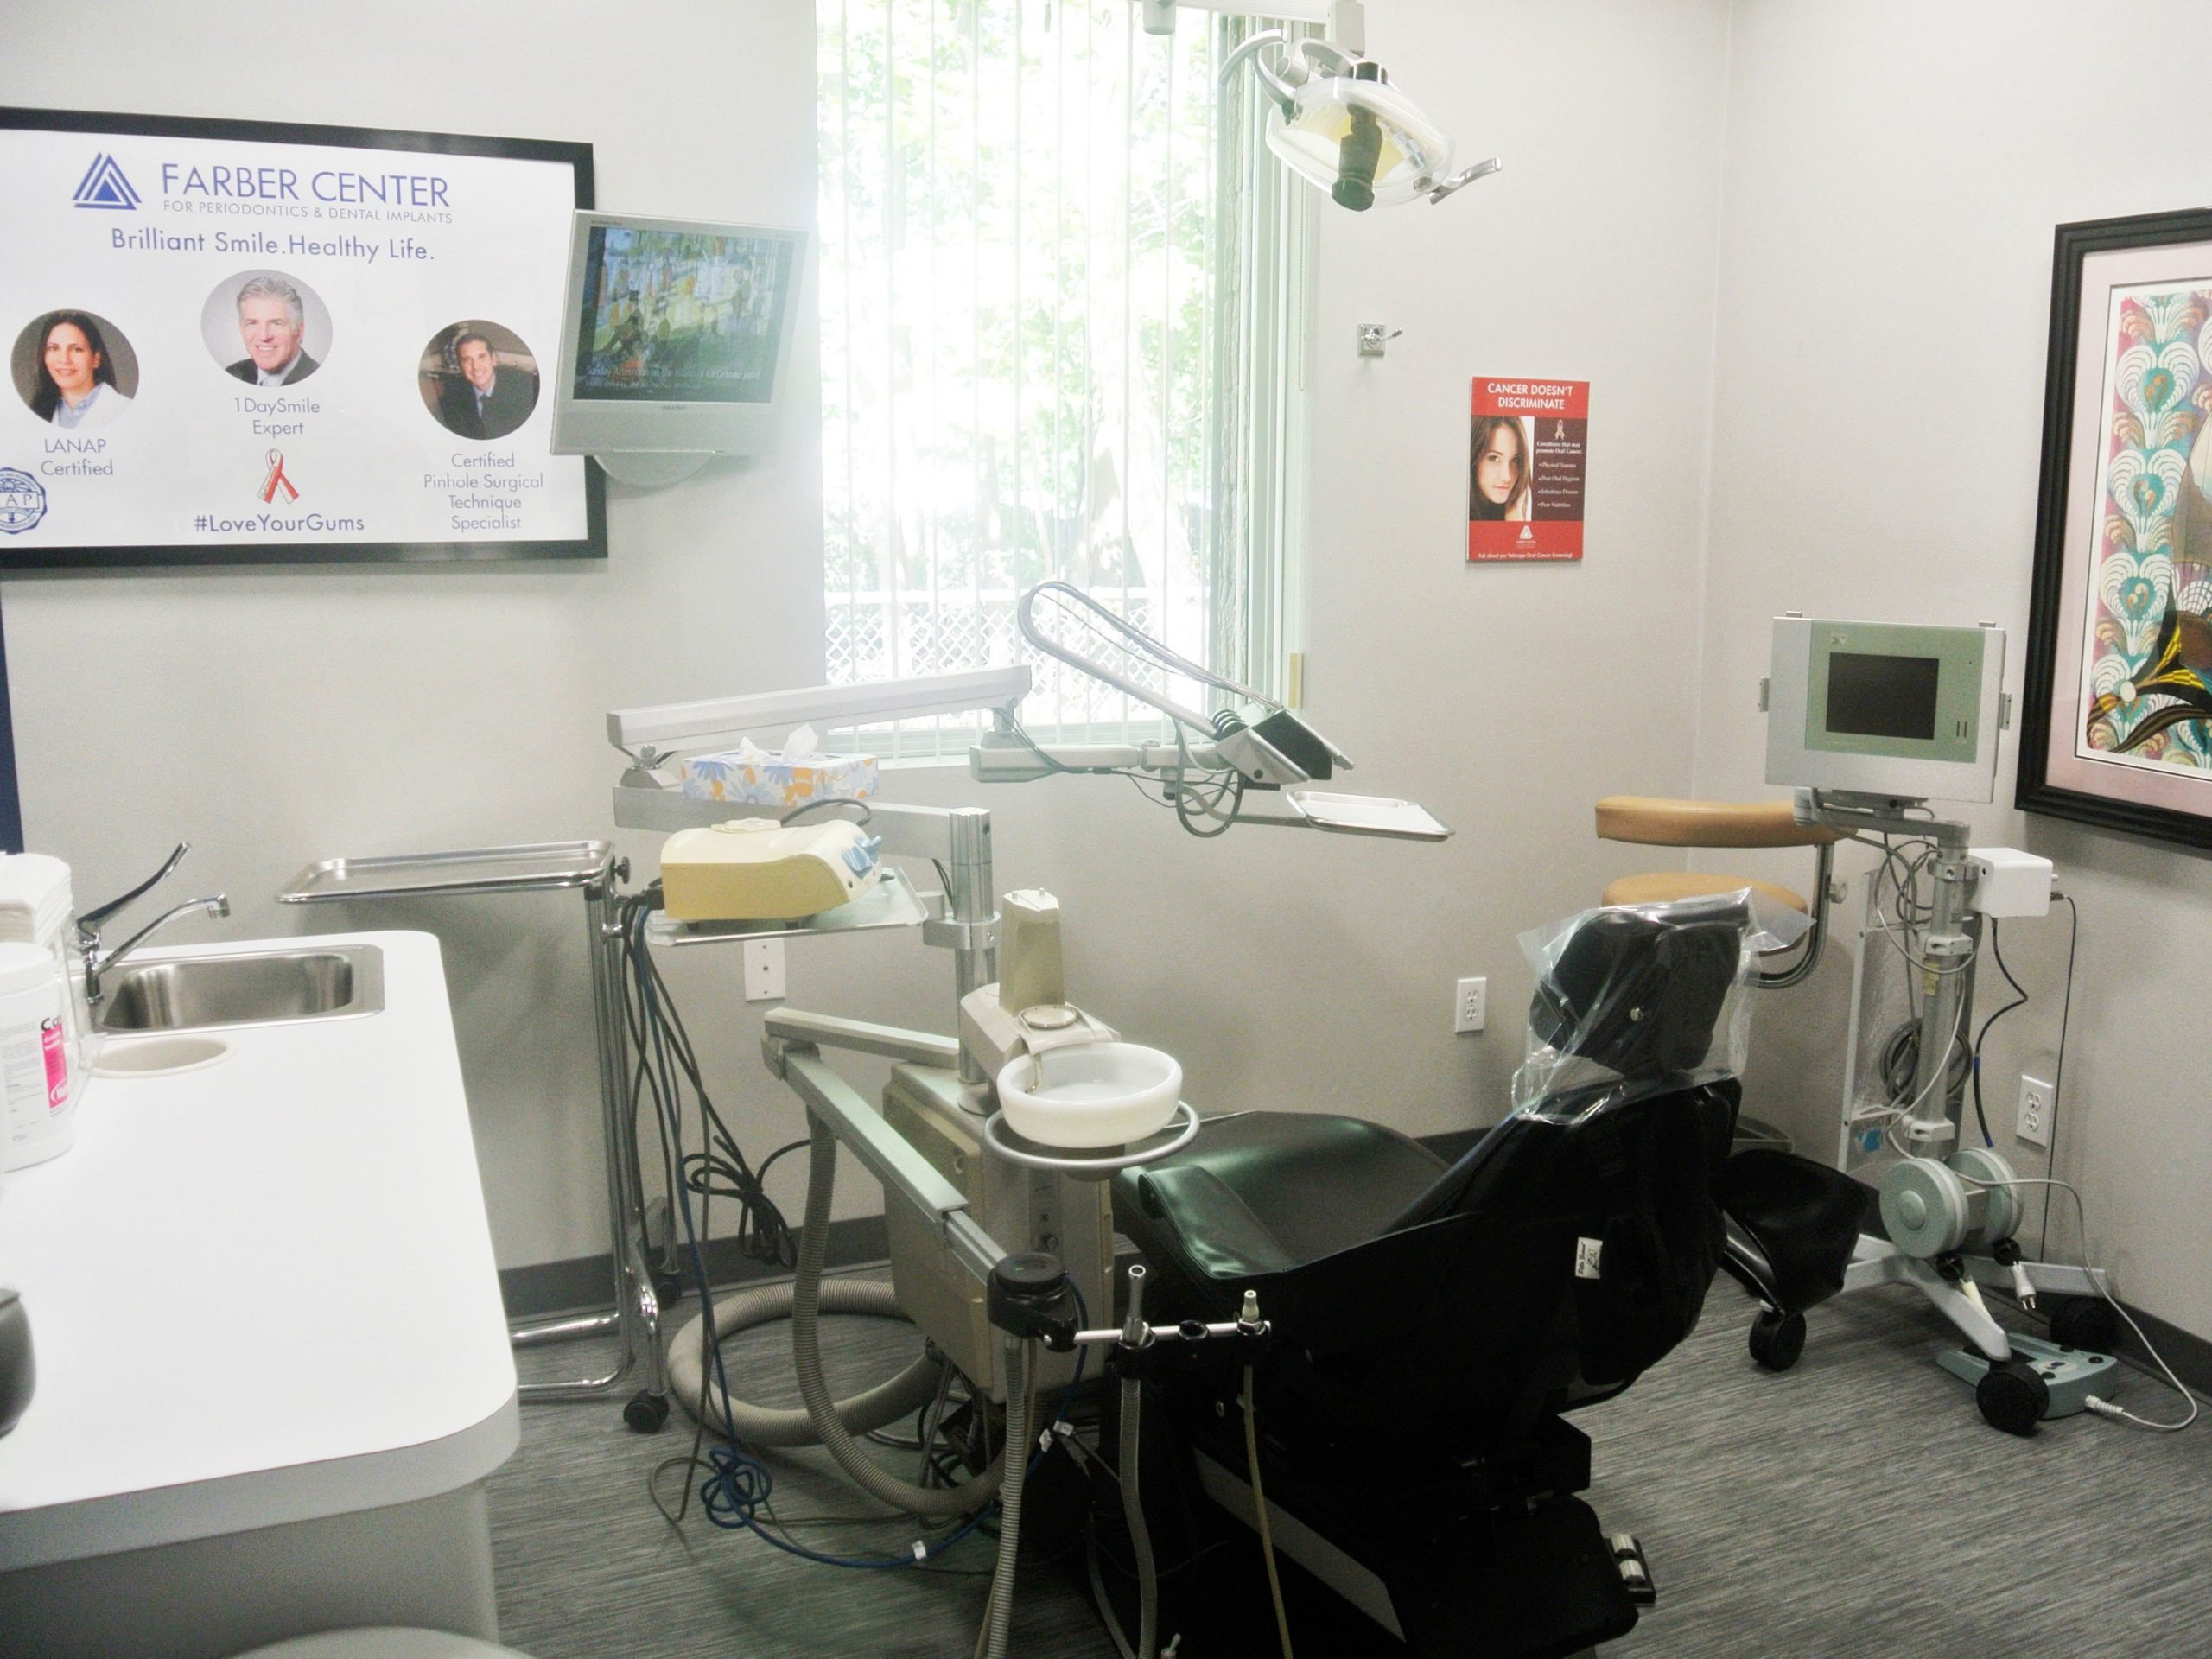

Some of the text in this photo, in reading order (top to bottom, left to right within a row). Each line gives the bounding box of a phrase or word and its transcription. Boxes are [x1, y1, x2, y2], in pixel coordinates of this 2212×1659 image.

[162, 163, 449, 207] FARBER CENTER
[163, 200, 453, 224] FOR PERIODONTICS & DENTAL IMPLANTS
[111, 227, 205, 251] Brilliant
[390, 238, 435, 259] Life.
[1487, 383, 1573, 397] CANCER DOESN'T
[234, 397, 320, 416] 1DaySmile
[1498, 397, 1565, 410] DISCRIMINATE
[252, 419, 303, 439] Expert
[44, 438, 107, 454] LANAP
[41, 458, 114, 476] Certified
[451, 451, 515, 467] Certified
[423, 472, 543, 493] Pinhole Surgical
[448, 493, 522, 512] Technique
[194, 513, 365, 532] #LoveYourGums
[451, 513, 521, 533] Specialist
